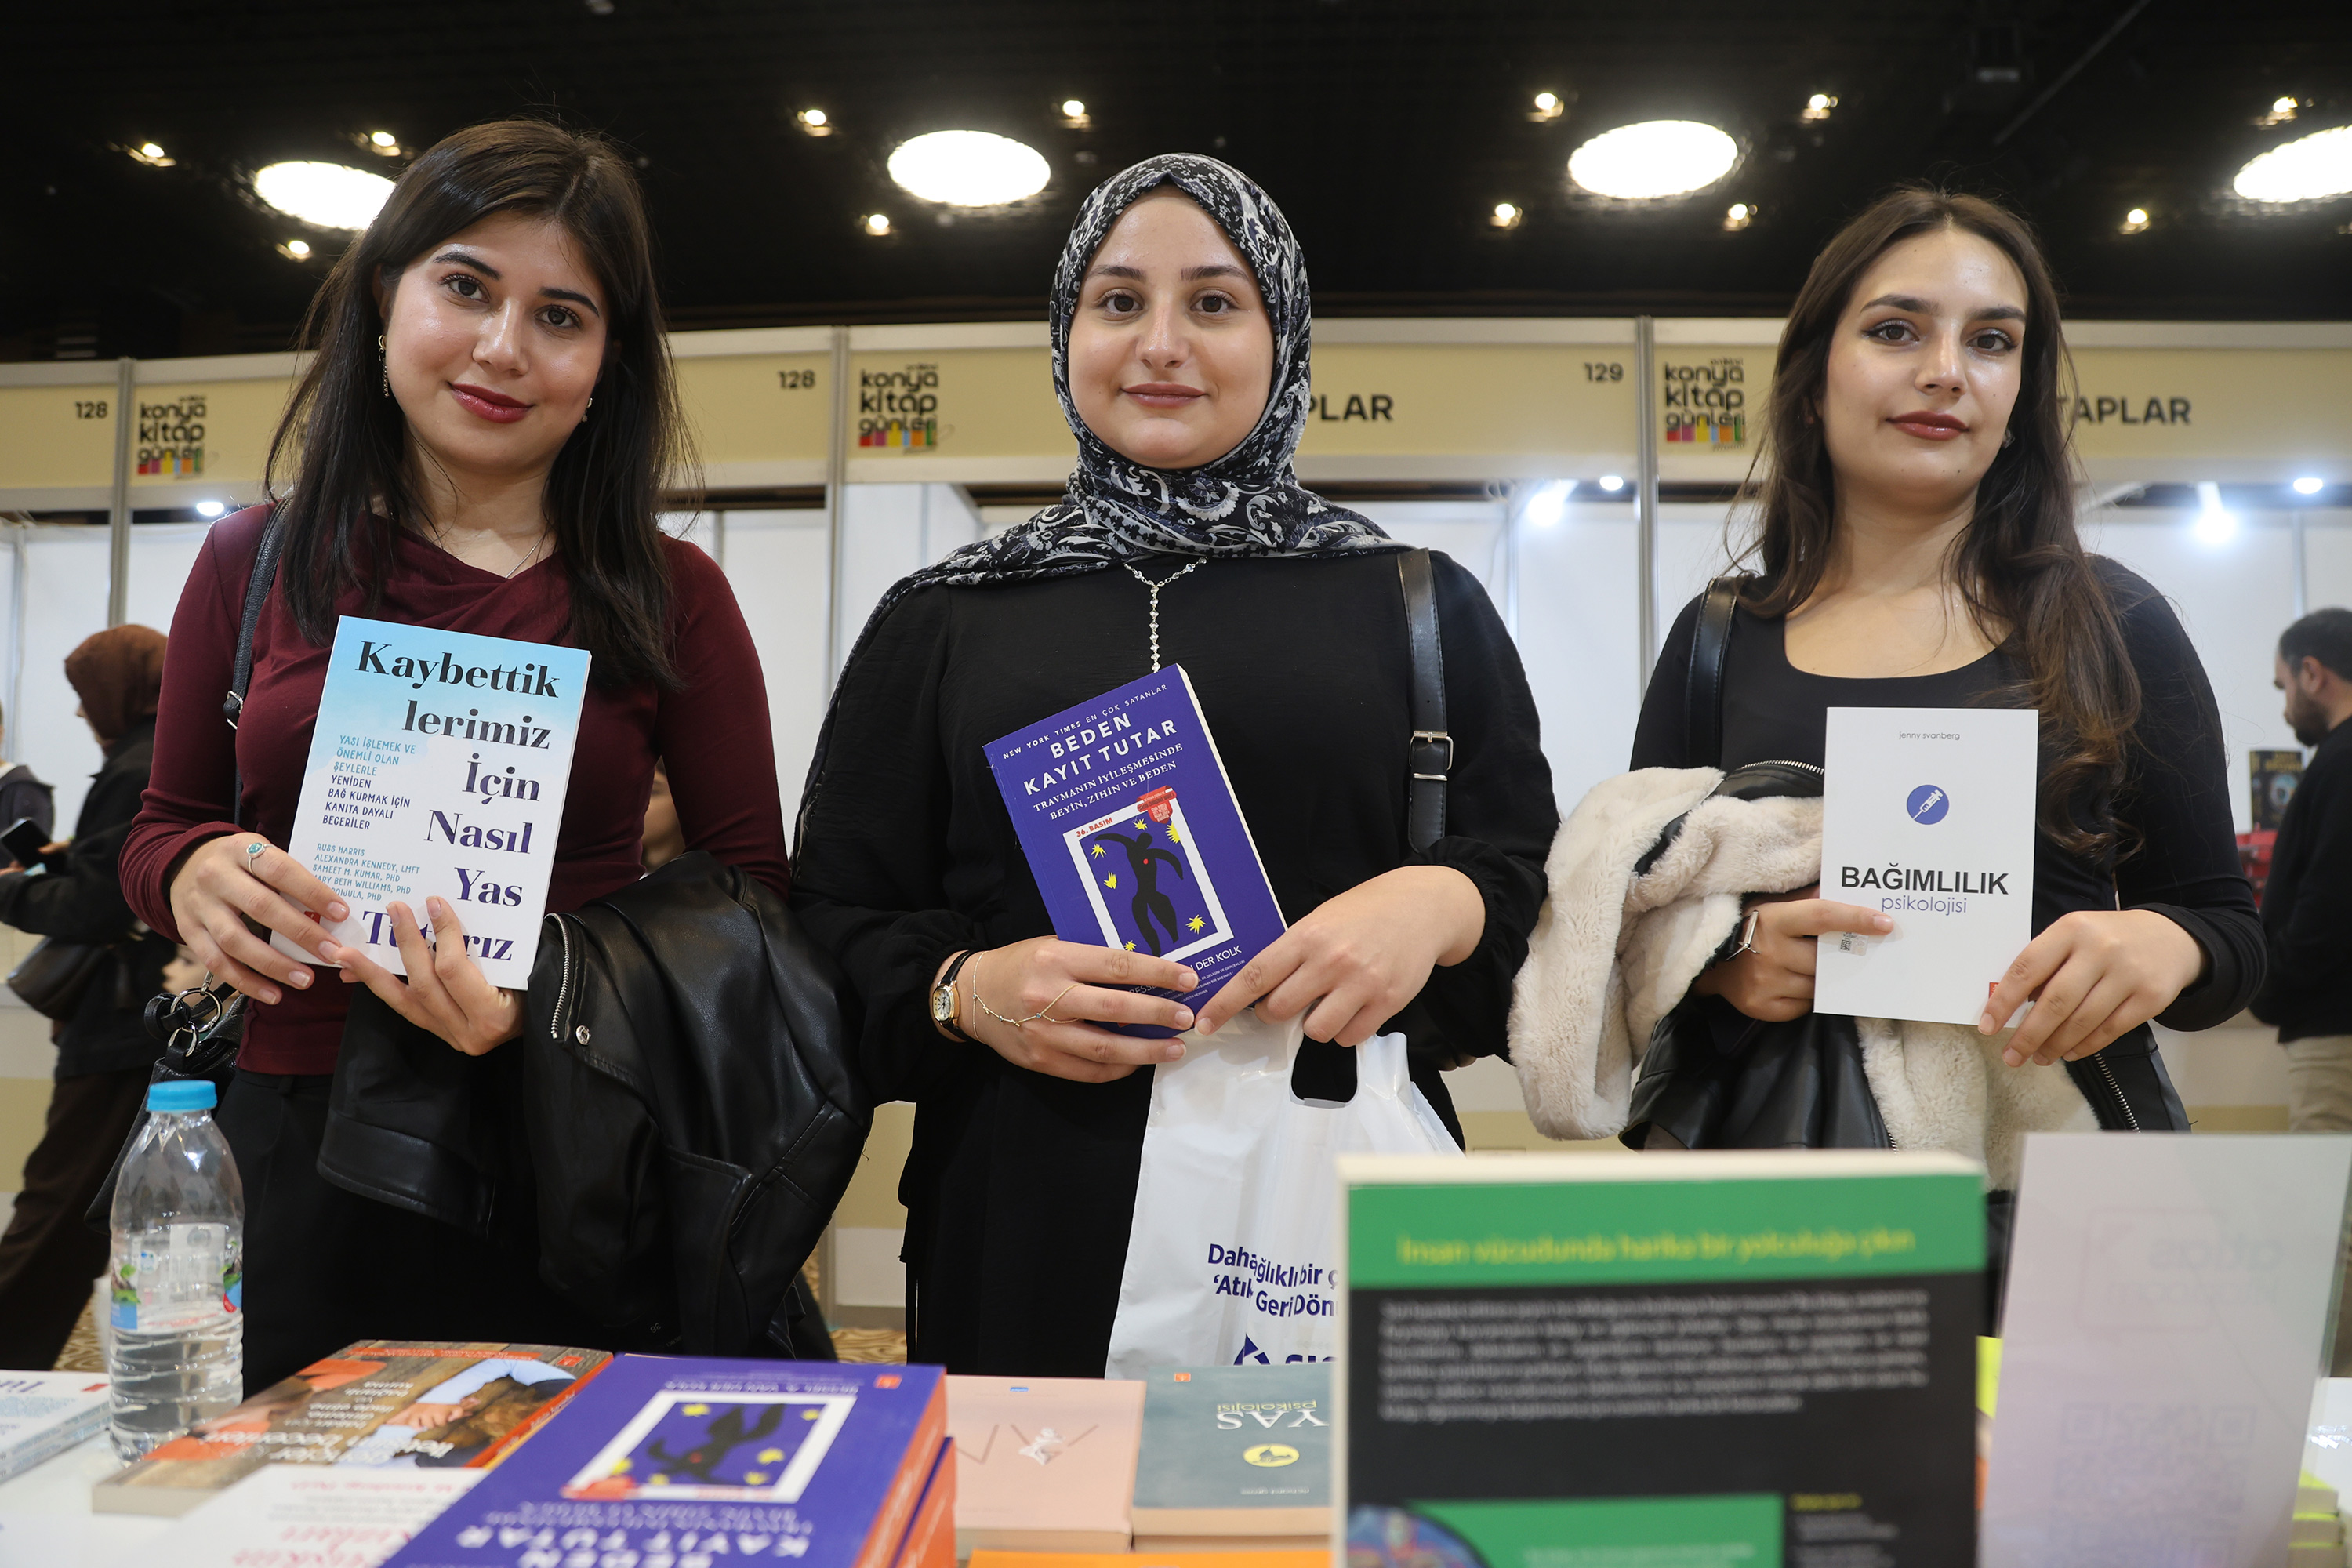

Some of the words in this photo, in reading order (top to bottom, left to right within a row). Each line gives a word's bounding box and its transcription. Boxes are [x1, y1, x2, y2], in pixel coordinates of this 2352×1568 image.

[776, 369, 816, 390] 128
[861, 368, 939, 391] konya
[1584, 362, 1624, 383] 129
[1665, 361, 1744, 387] konya
[859, 391, 938, 416] kitap
[1665, 383, 1744, 411] kitap
[75, 401, 108, 419] 128
[140, 402, 206, 424] konya
[1666, 408, 1745, 431] günleri
[2057, 394, 2192, 424] APLAR
[139, 422, 205, 443] kitap
[354, 640, 561, 699] Kaybettik
[401, 699, 552, 750] lerimiz
[1003, 746, 1022, 760] NEW
[1026, 735, 1051, 749] YORK
[1054, 720, 1082, 736] TIMES
[1085, 714, 1098, 724] EN
[1102, 704, 1120, 717] ÇOK
[1124, 684, 1167, 706] SATANLAR
[339, 735, 360, 746] YASI
[362, 736, 401, 752] İŞLEMEK
[405, 744, 416, 754] VE
[1050, 713, 1131, 759] BEDEN
[1899, 731, 1921, 740] jenny
[1922, 731, 1961, 741] svanberg
[336, 747, 372, 761] ÖNEMLİ
[375, 753, 400, 765] OLAN
[1023, 753, 1092, 797] KAYIT
[1098, 719, 1178, 762] TUTAR
[333, 761, 378, 776] ŞEYLERLE
[462, 752, 540, 804] İçin
[1033, 779, 1097, 812] TRAVMANIN
[1098, 742, 1184, 784] İYİLEŞMESİNDE
[331, 775, 372, 789] YENİDEN
[1049, 798, 1087, 820] BEYİN,
[1087, 784, 1121, 804] ZİHİN
[1122, 777, 1137, 789] VE
[1138, 760, 1178, 782] BEDEN
[328, 788, 347, 799] BAĞ
[349, 791, 388, 805] KURMAK
[391, 795, 411, 808] İÇİN
[325, 801, 358, 815] KANITA
[362, 807, 394, 819] DAYALI
[423, 809, 533, 855] Nasıl
[1076, 827, 1089, 837] 36.
[1089, 817, 1113, 832] BASIM
[317, 843, 336, 853] RUSS
[338, 846, 365, 857] HARRIS
[312, 864, 342, 875] SAMEET
[343, 868, 352, 877] M.
[354, 869, 383, 881] KUMAR,
[386, 873, 401, 882] PHD
[314, 854, 359, 866] ALEXANDRA
[361, 860, 399, 873] KENNEDY,
[401, 865, 421, 874] LMFT
[334, 877, 352, 887] BETH
[355, 880, 394, 894] WILLIAMS,
[396, 886, 411, 895] PHD
[454, 867, 523, 907] Yas
[1841, 862, 2009, 895] BAĞIMLILIK
[367, 892, 382, 901] PHD
[1882, 895, 1967, 916] psikolojisi
[362, 910, 514, 961] Ttrız
[1195, 956, 1215, 971] DER
[1215, 945, 1242, 962] KOLK
[1299, 1261, 1323, 1286] bir
[1256, 1290, 1294, 1318] Geri
[1217, 1399, 1317, 1413] psikolojisi
[1216, 1409, 1330, 1430] YAS
